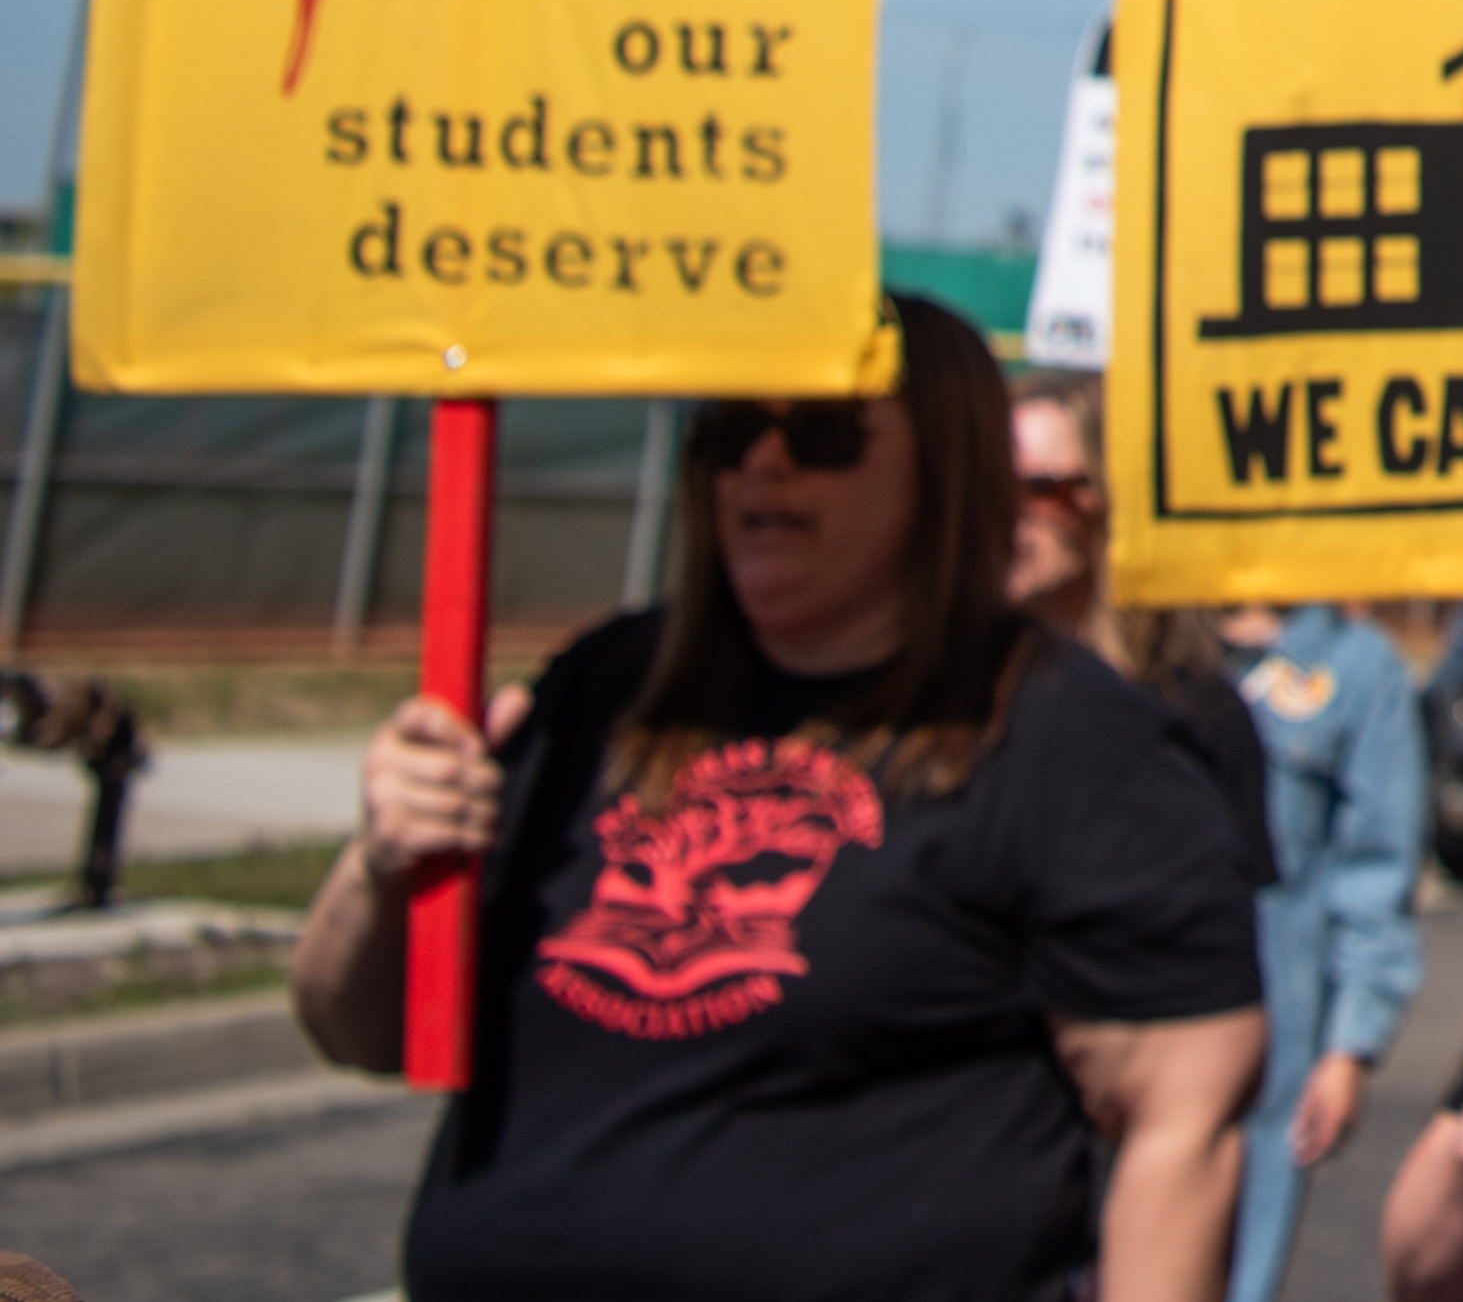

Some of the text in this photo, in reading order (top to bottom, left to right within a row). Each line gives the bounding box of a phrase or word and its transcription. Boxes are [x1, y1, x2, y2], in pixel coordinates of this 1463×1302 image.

[612, 20, 791, 77] our
[326, 98, 788, 182] students
[350, 203, 787, 295] deserve
[1216, 379, 1343, 486] WE
